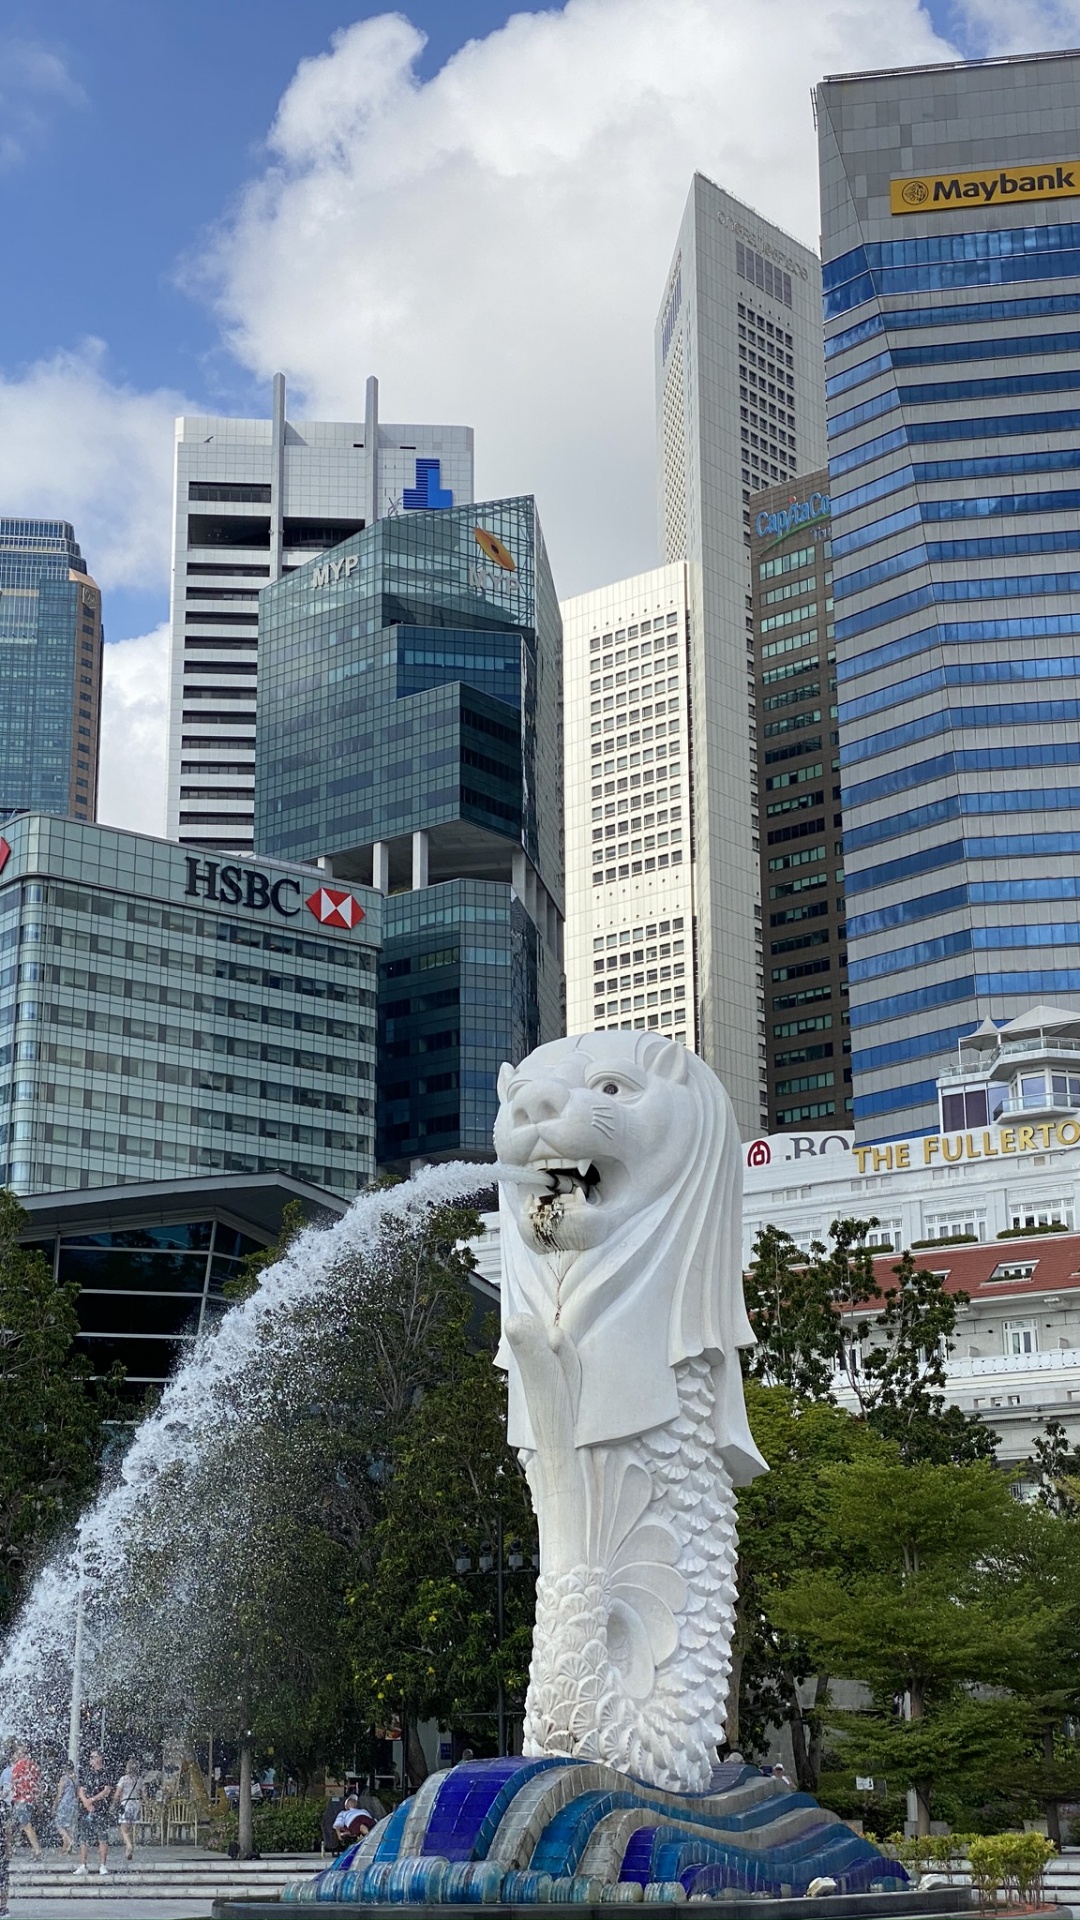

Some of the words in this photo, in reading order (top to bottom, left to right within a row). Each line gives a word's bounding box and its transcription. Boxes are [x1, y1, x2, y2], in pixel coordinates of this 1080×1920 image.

[933, 167, 1076, 202] Maybank
[312, 554, 360, 589] MYP
[469, 568, 520, 595] MYP
[184, 856, 301, 917] HSBC
[851, 1143, 911, 1173] THE
